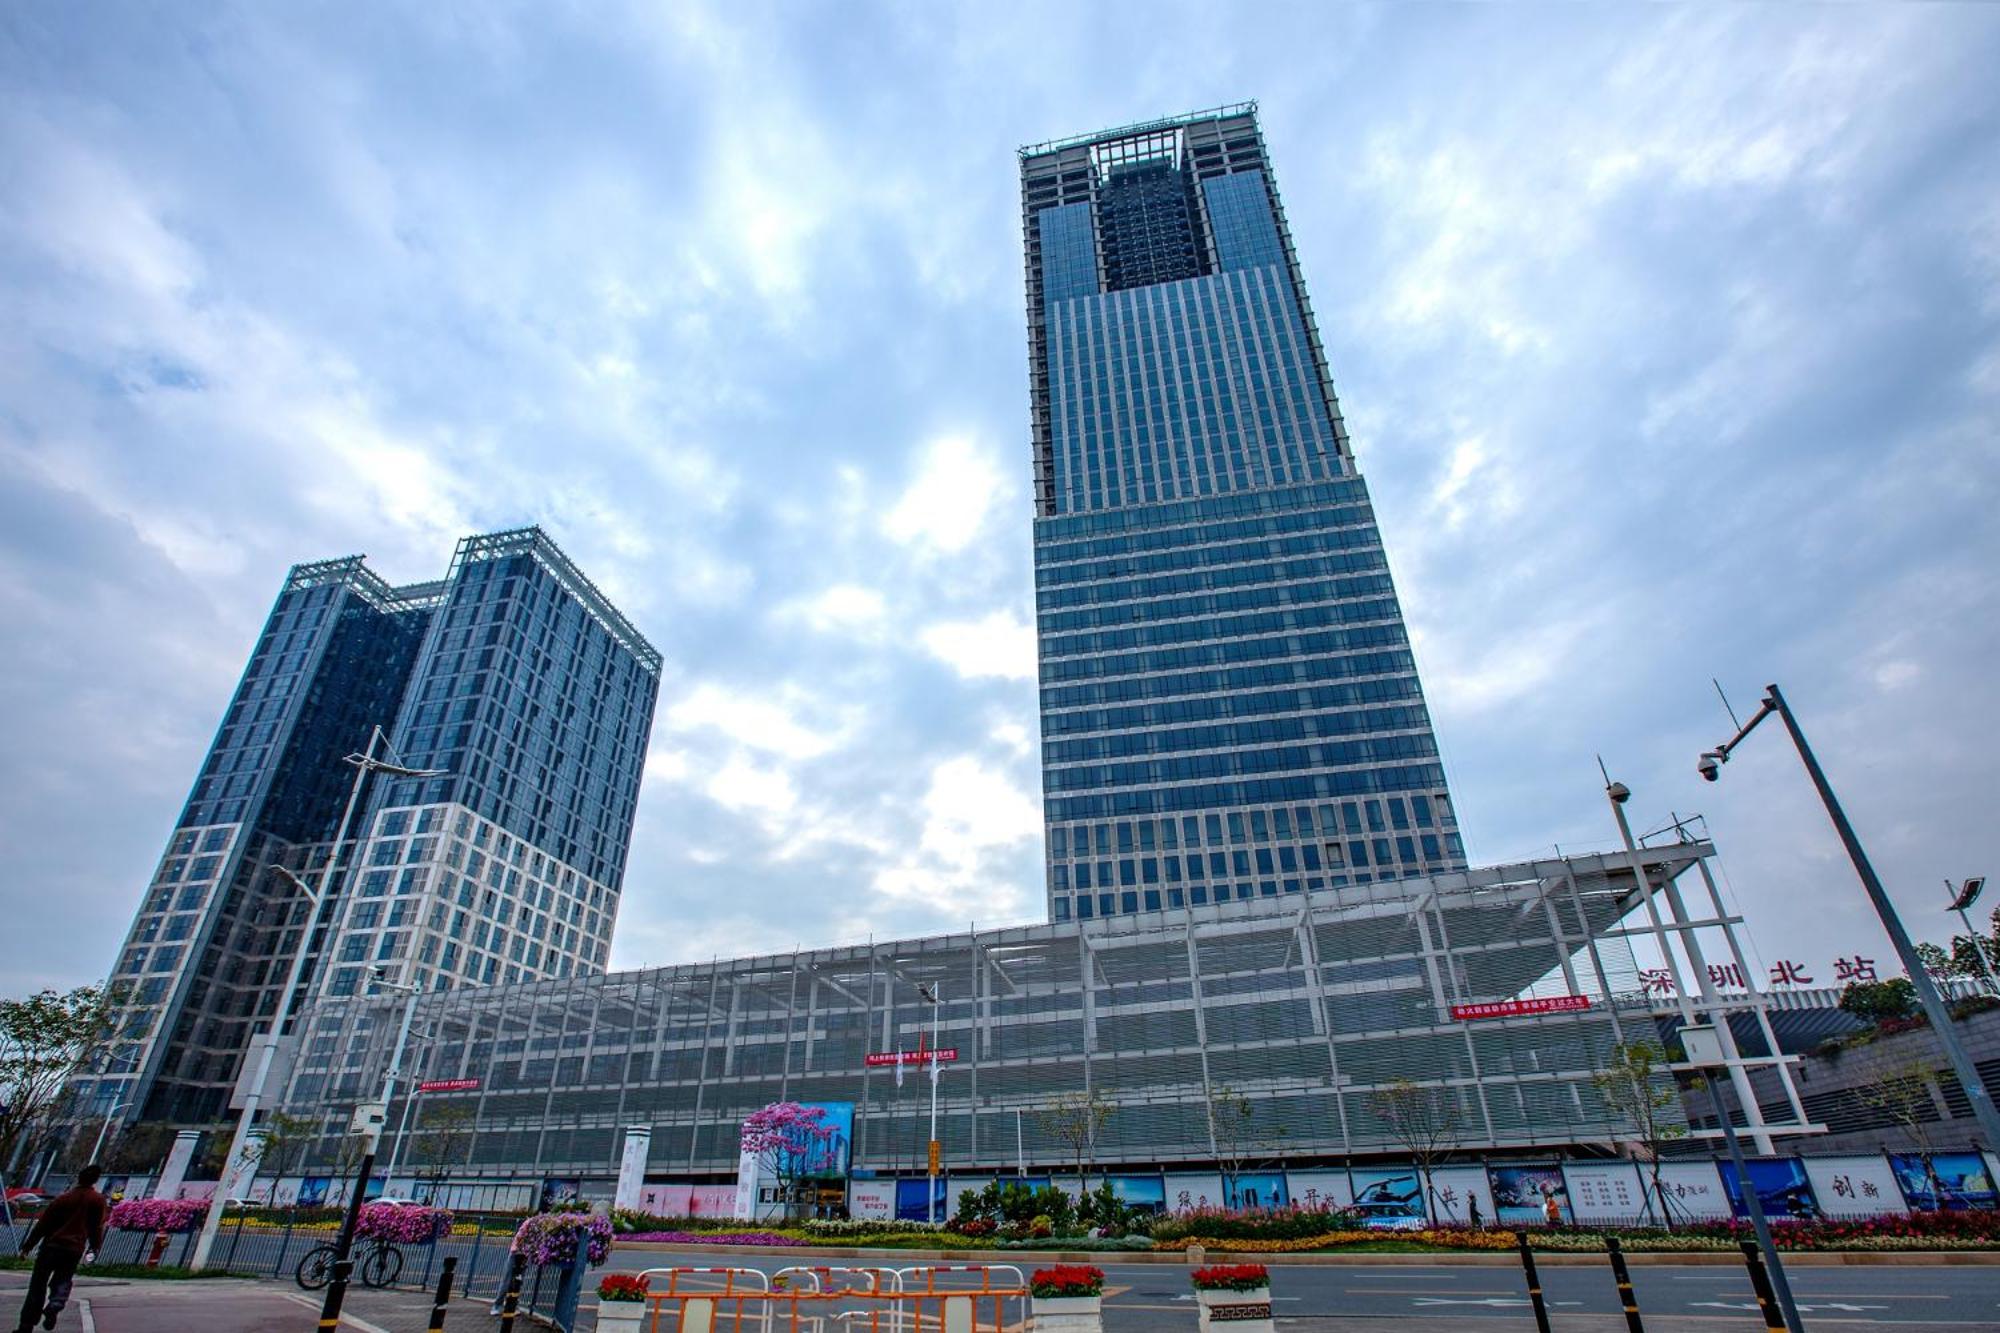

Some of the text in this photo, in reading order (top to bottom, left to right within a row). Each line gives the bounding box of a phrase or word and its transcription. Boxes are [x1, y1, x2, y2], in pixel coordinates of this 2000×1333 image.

[1639, 955, 1878, 993] 深圳北站
[1832, 1175, 1879, 1200] 创新
